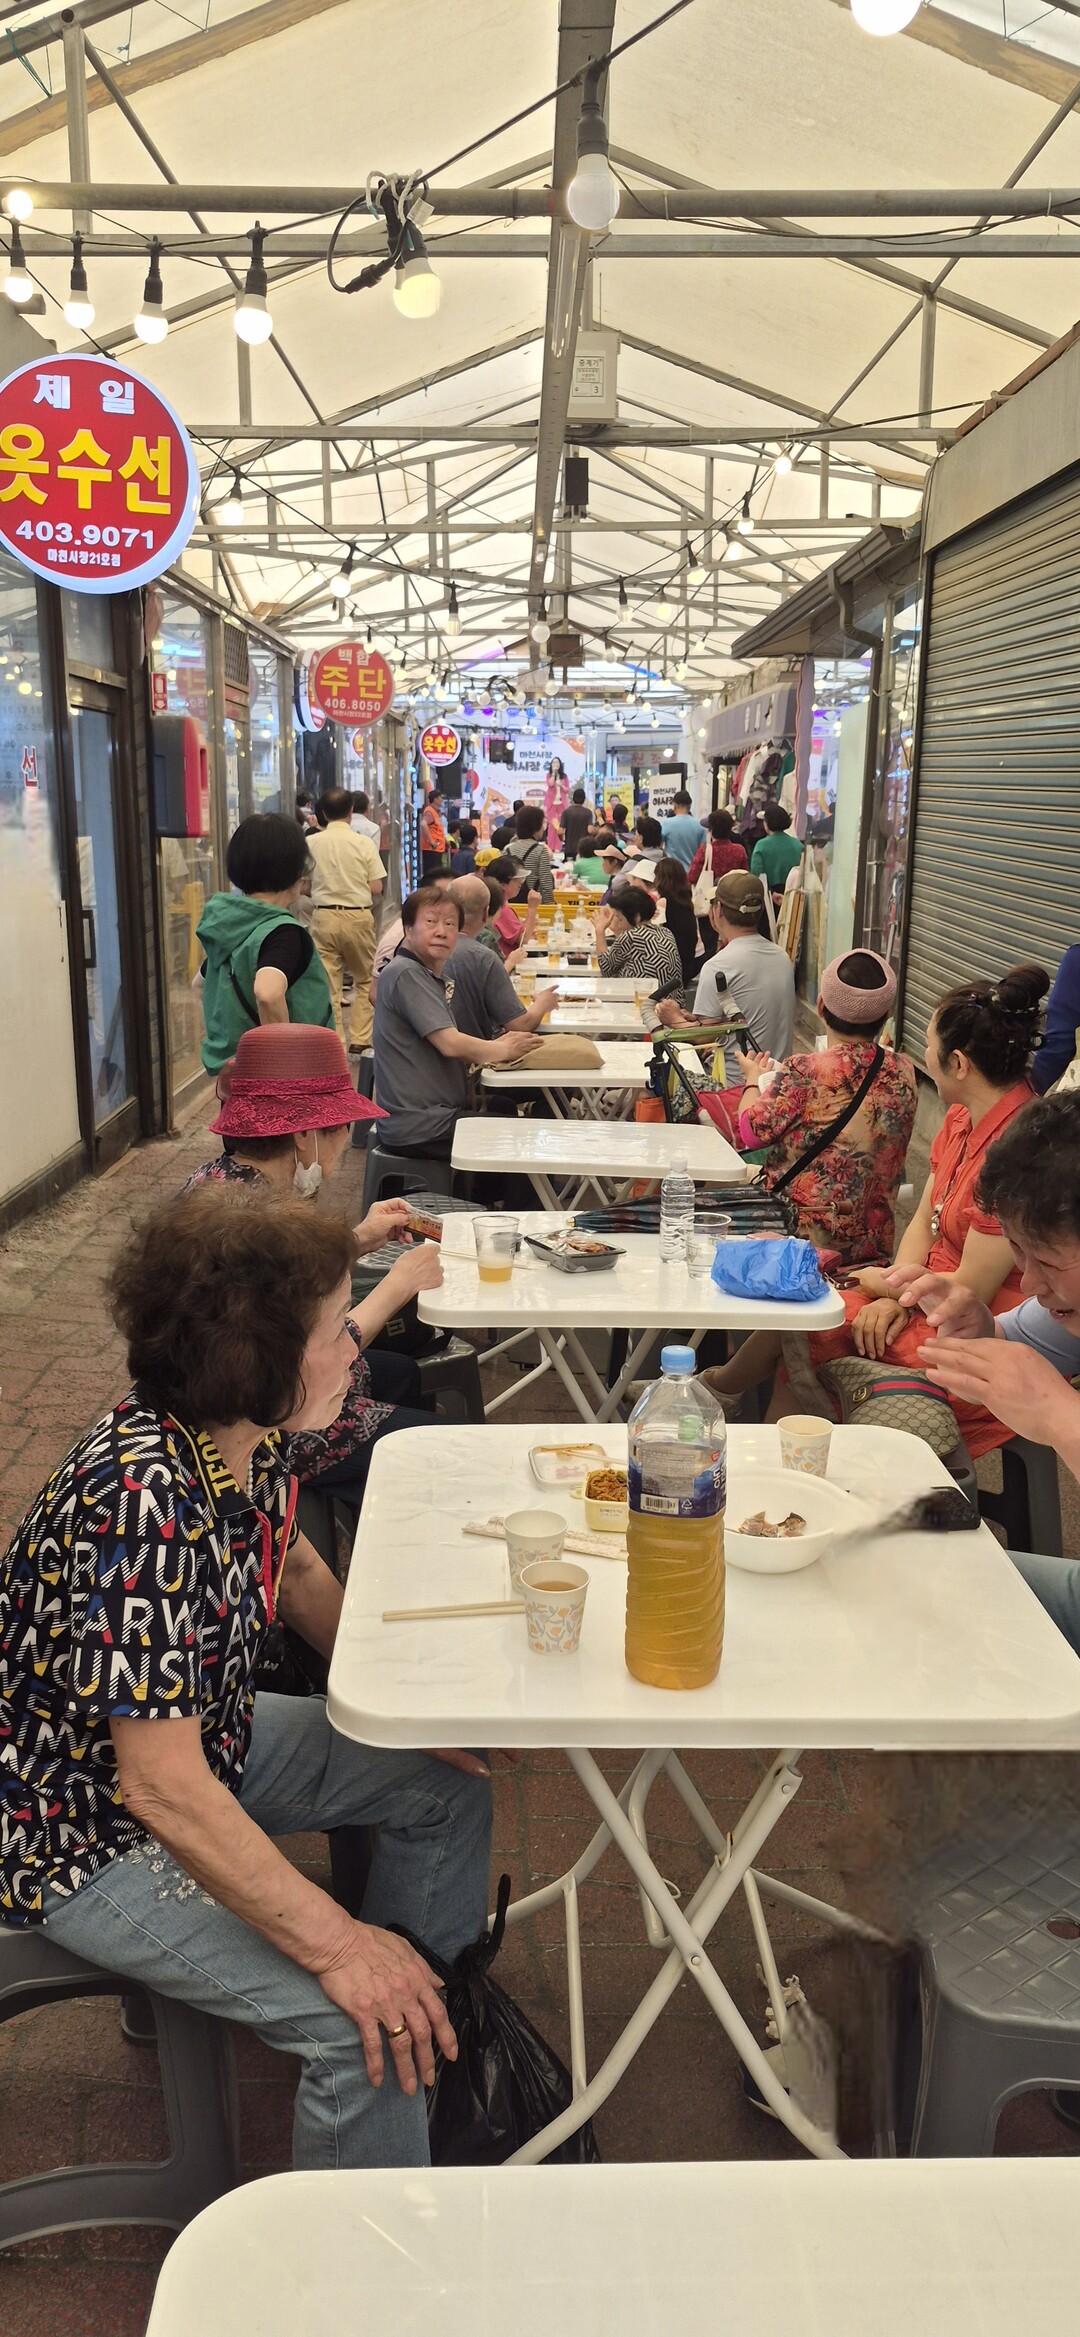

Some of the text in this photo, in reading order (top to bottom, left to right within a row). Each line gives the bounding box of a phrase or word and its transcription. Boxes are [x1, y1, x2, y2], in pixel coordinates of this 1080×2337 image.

[594, 386, 599, 394] 3
[0, 423, 171, 515] 옷수선
[16, 520, 154, 549] 403.9071
[325, 697, 381, 712] 406.8050
[423, 735, 457, 753] 옷수선
[519, 750, 552, 759] 마천시장
[653, 788, 677, 796] 마천시장
